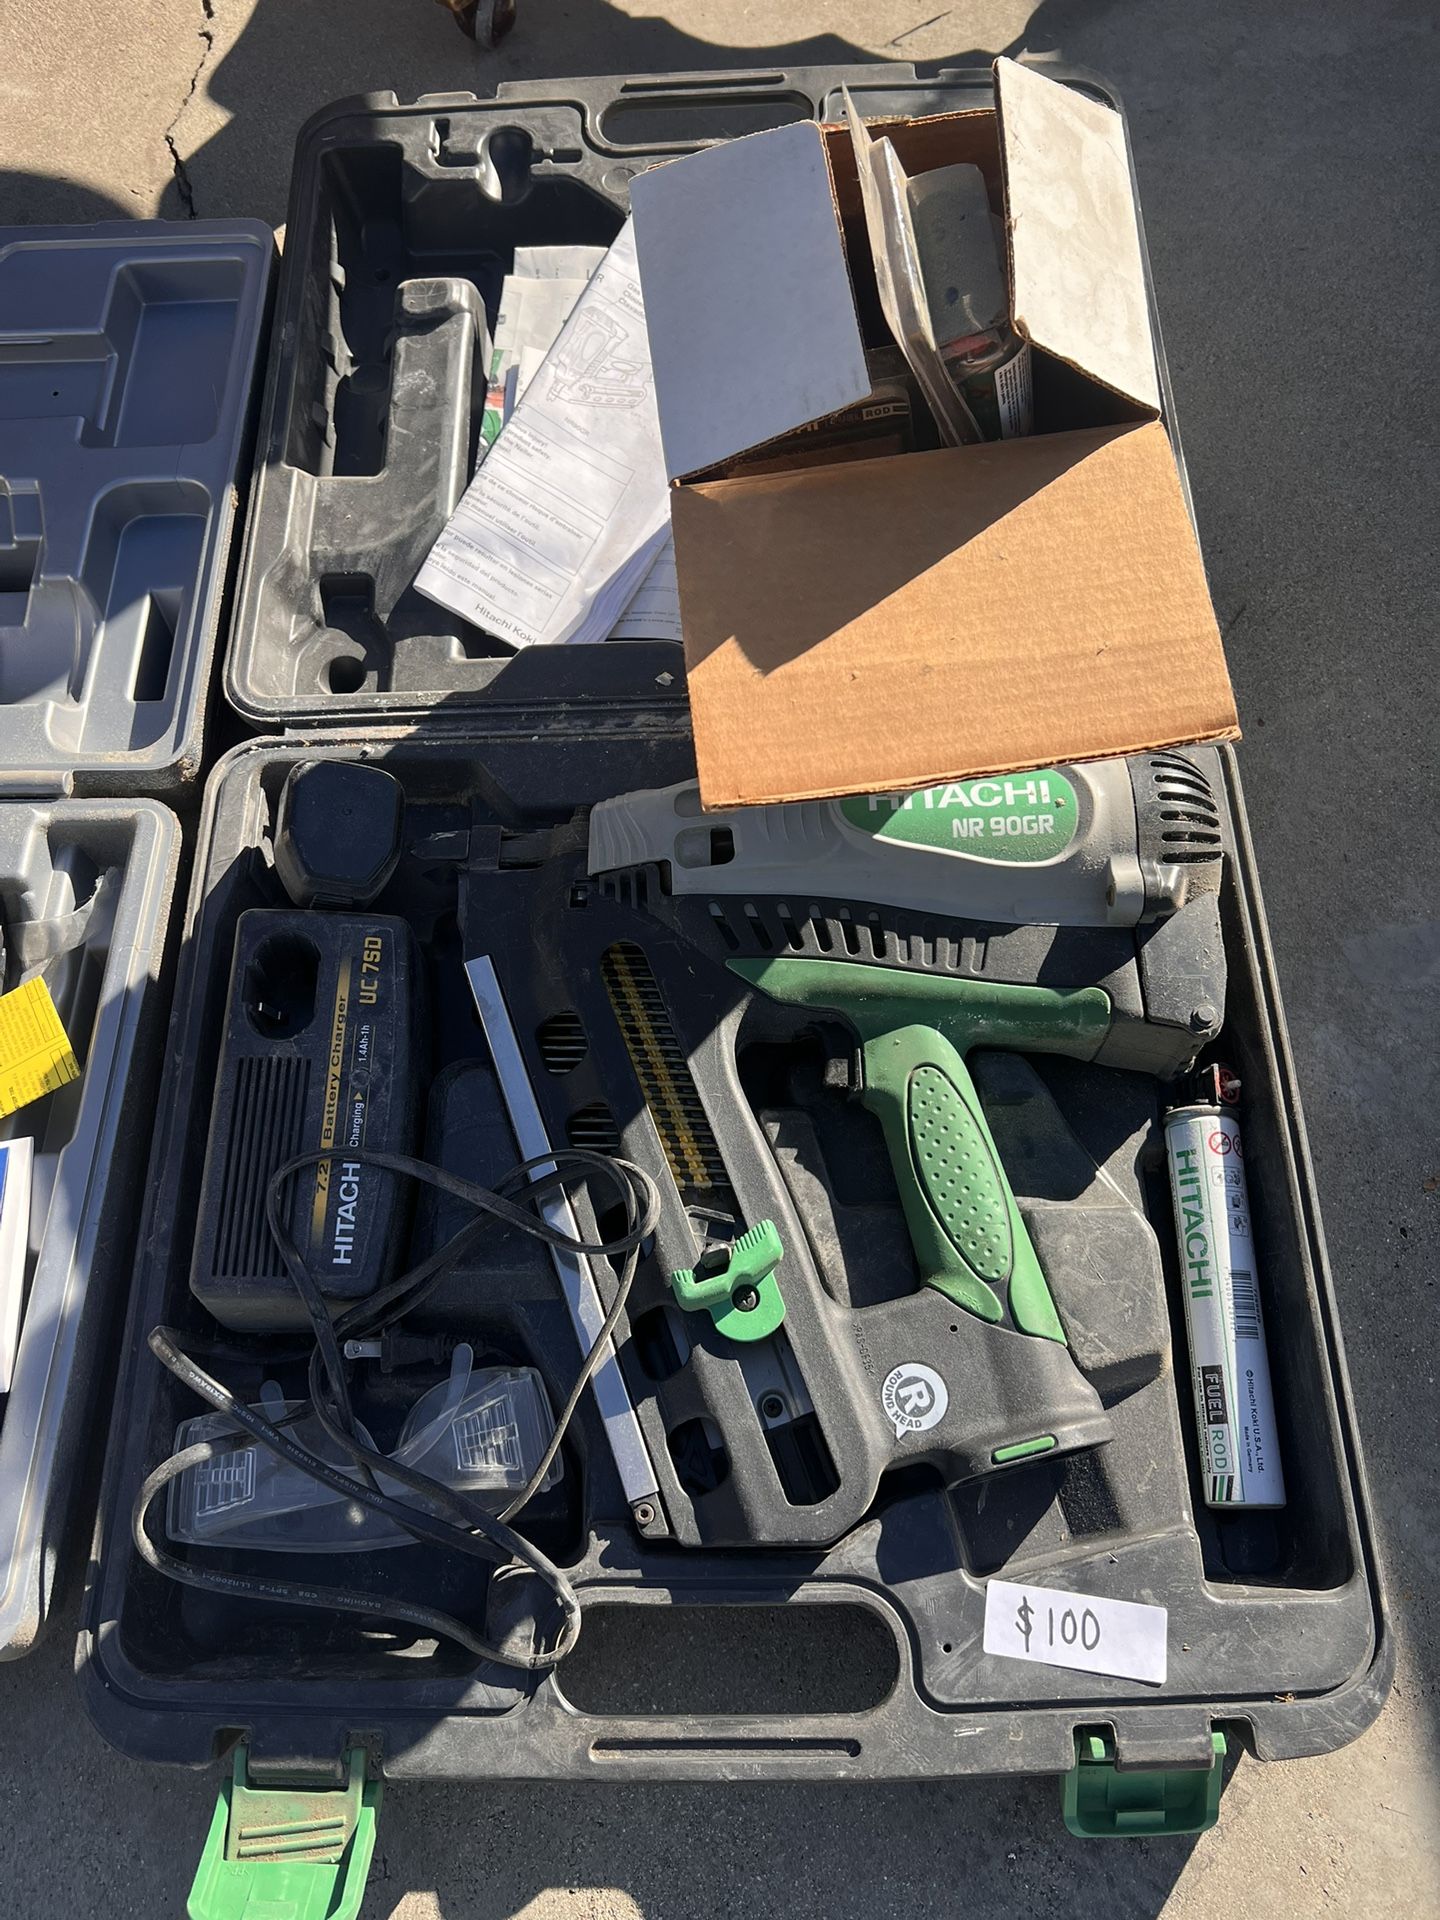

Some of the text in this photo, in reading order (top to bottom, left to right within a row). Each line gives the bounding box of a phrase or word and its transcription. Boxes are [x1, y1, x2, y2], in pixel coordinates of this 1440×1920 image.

[452, 534, 475, 552] puede
[473, 547, 499, 566] resultar
[498, 562, 509, 572] en
[473, 602, 537, 646] Hitachi Koki
[868, 780, 1052, 811] HITACHI
[952, 814, 1055, 839] NR 90GR
[359, 976, 378, 1005] UC
[358, 1023, 370, 1062] 1.4Ah-1h
[316, 994, 348, 1194] 7.2 Battery Charger
[348, 1101, 365, 1148] Charging
[333, 1161, 361, 1265] HITACH
[1175, 1148, 1213, 1300] HITACHI
[884, 1370, 922, 1429] ROUND HEAD
[898, 1380, 931, 1414] R
[1203, 1371, 1225, 1422] FUEL
[1246, 1378, 1264, 1473] Hitachi Koki U.S.A., Ltd.
[1210, 1429, 1228, 1469] ROD
[1245, 1448, 1254, 1473] Germany
[1014, 1595, 1101, 1653] $100
